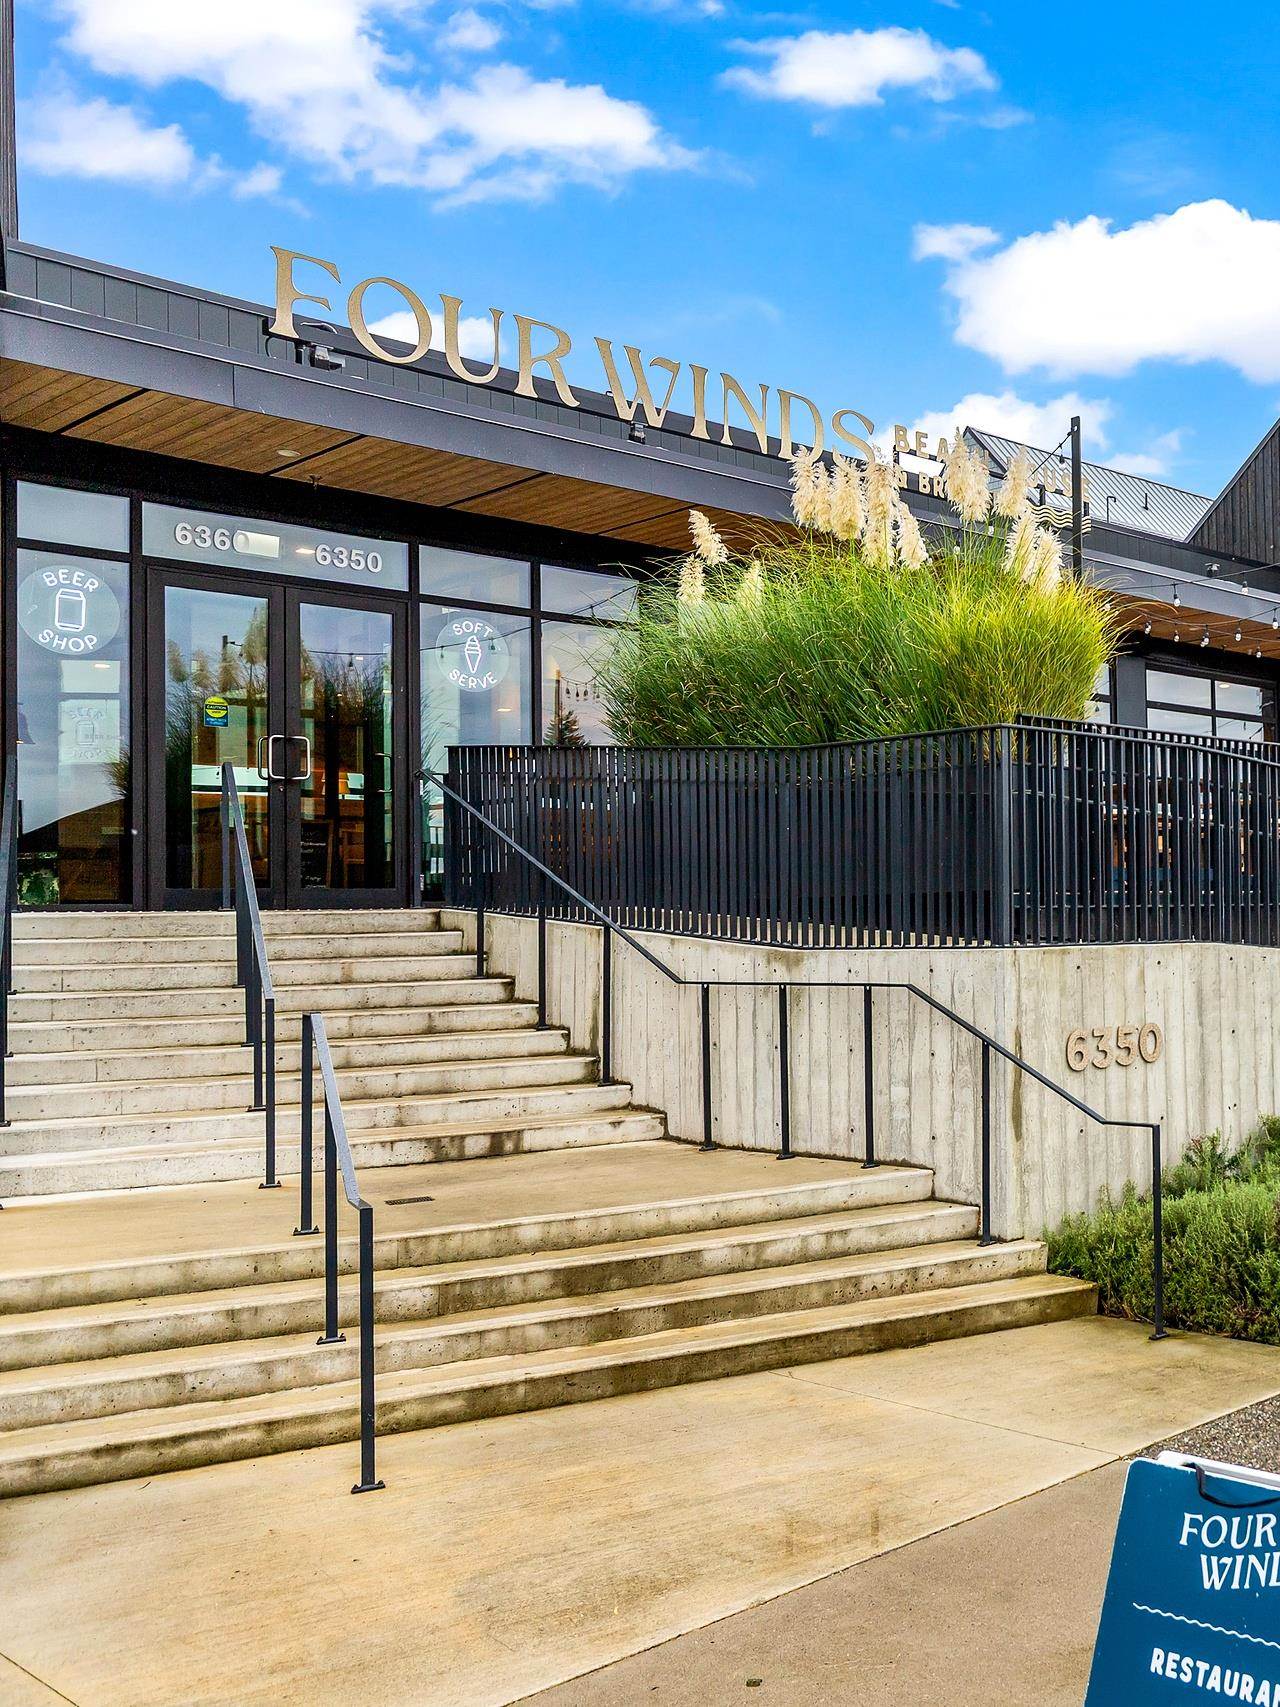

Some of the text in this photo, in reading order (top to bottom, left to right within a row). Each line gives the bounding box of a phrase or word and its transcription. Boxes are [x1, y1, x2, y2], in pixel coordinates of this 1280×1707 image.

[269, 246, 874, 464] FOUR WINDS
[174, 522, 250, 553] 6360
[315, 544, 383, 573] 6350
[42, 568, 99, 592] BEER
[38, 629, 98, 652] SHOP
[452, 620, 493, 638] SOFT
[449, 668, 498, 689] SERVE
[1066, 1022, 1162, 1072] 6350
[1179, 1512, 1277, 1549] FOUR
